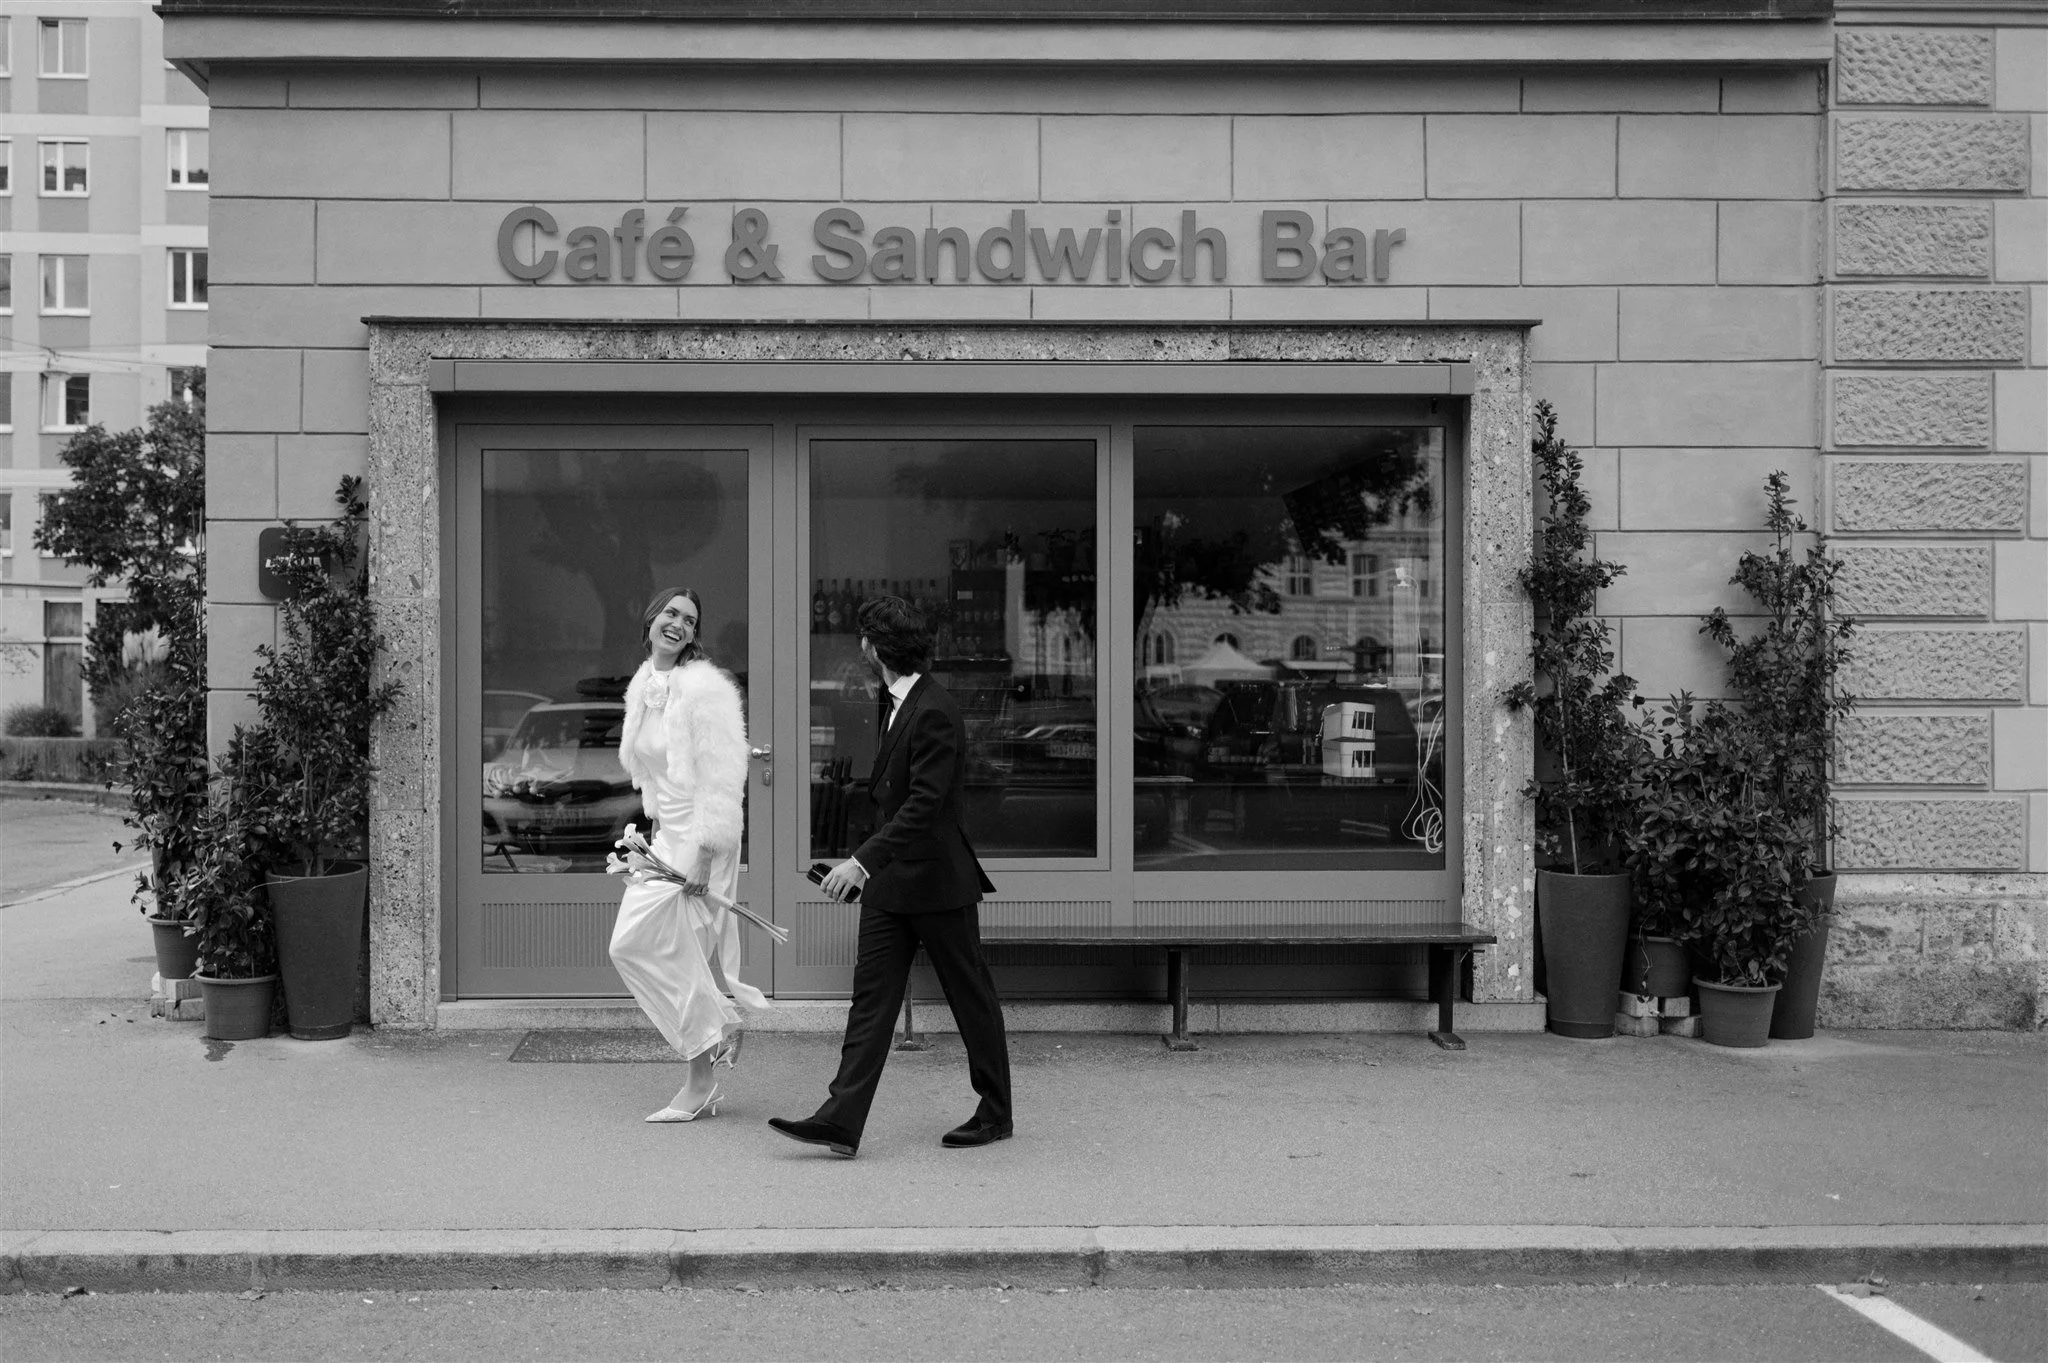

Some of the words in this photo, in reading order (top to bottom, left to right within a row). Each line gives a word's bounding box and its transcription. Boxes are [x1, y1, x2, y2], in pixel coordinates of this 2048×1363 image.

[498, 206, 695, 281] Café
[724, 207, 784, 280] &
[811, 206, 1227, 282] Sandwich
[1262, 209, 1406, 281] Bar
